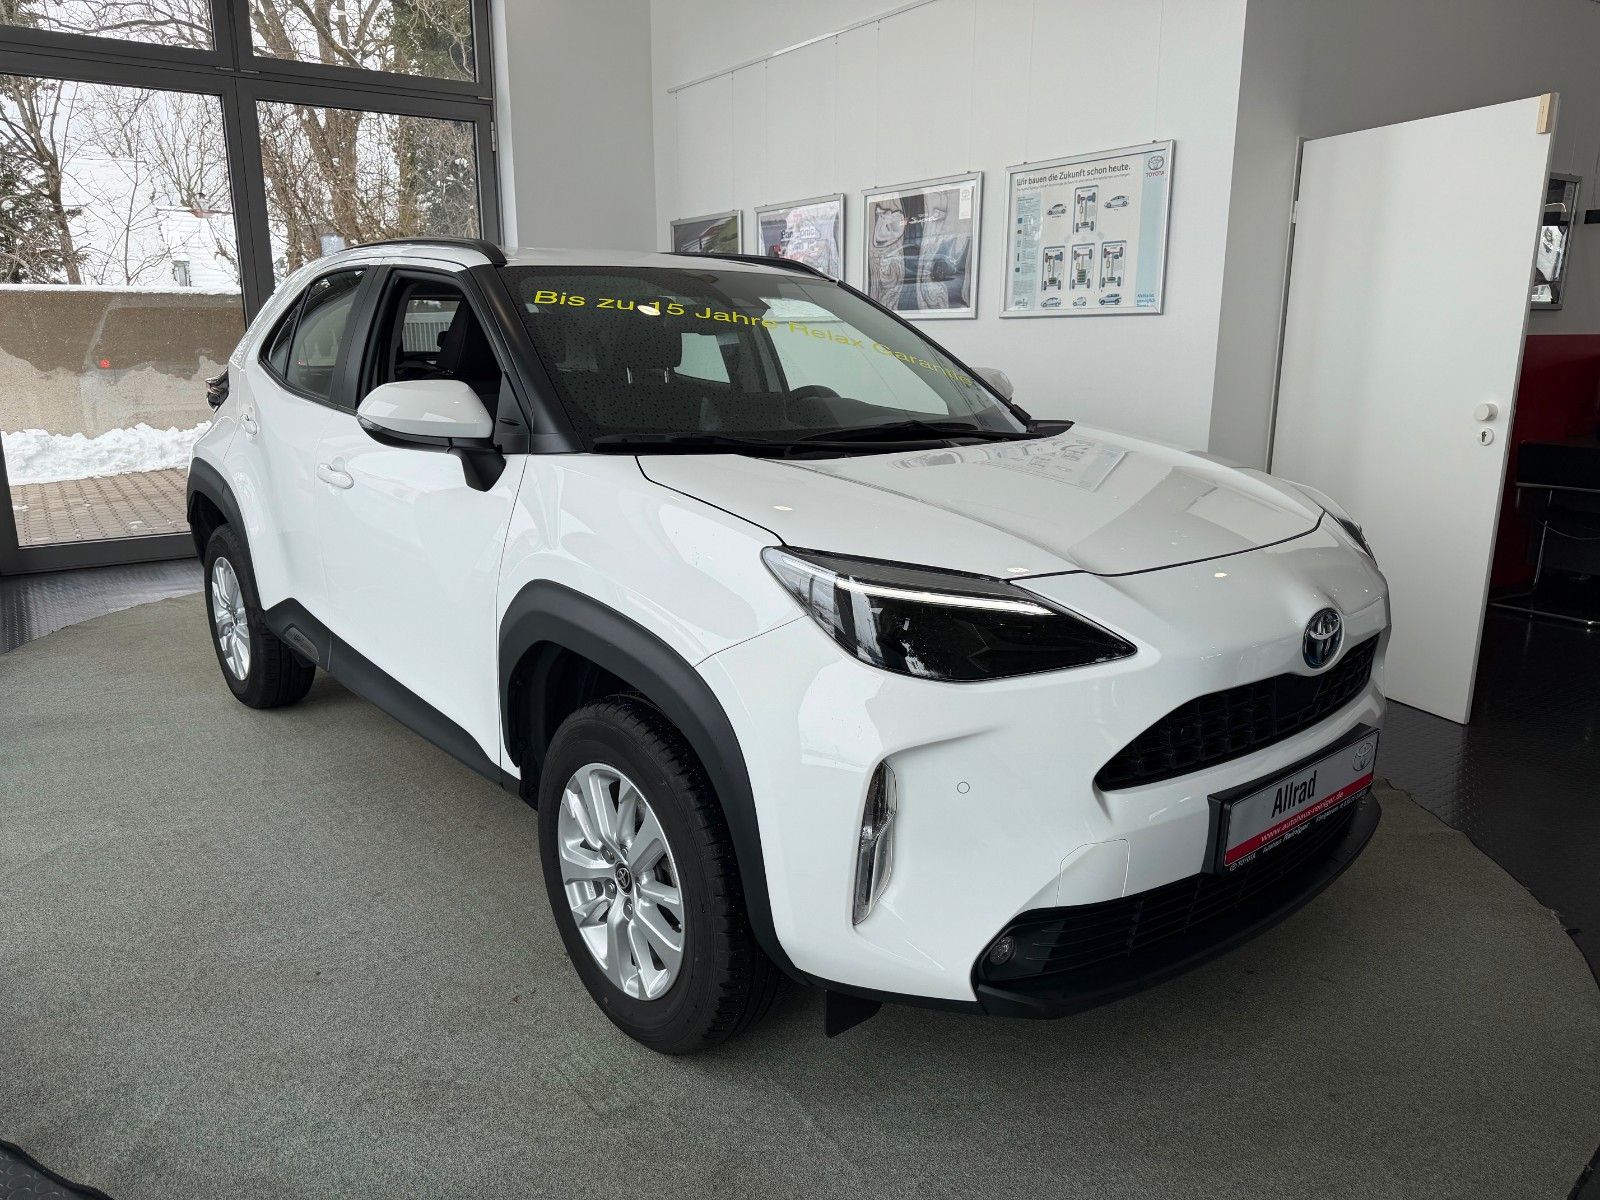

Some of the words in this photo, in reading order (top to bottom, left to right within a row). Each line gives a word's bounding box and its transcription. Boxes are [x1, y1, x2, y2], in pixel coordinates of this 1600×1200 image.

[1016, 176, 1027, 187] Wir
[1028, 175, 1047, 185] bauen
[1048, 173, 1058, 182] die
[1059, 168, 1086, 180] Zukunft
[1087, 166, 1108, 176] schon
[1108, 163, 1131, 173] heute.
[1145, 170, 1165, 178] TOYOTA
[534, 290, 586, 306] Bis
[597, 298, 635, 311] zu
[648, 301, 685, 316] 15
[695, 307, 777, 329] Jahre
[788, 321, 864, 348] Relax
[1271, 770, 1317, 819] Allrad
